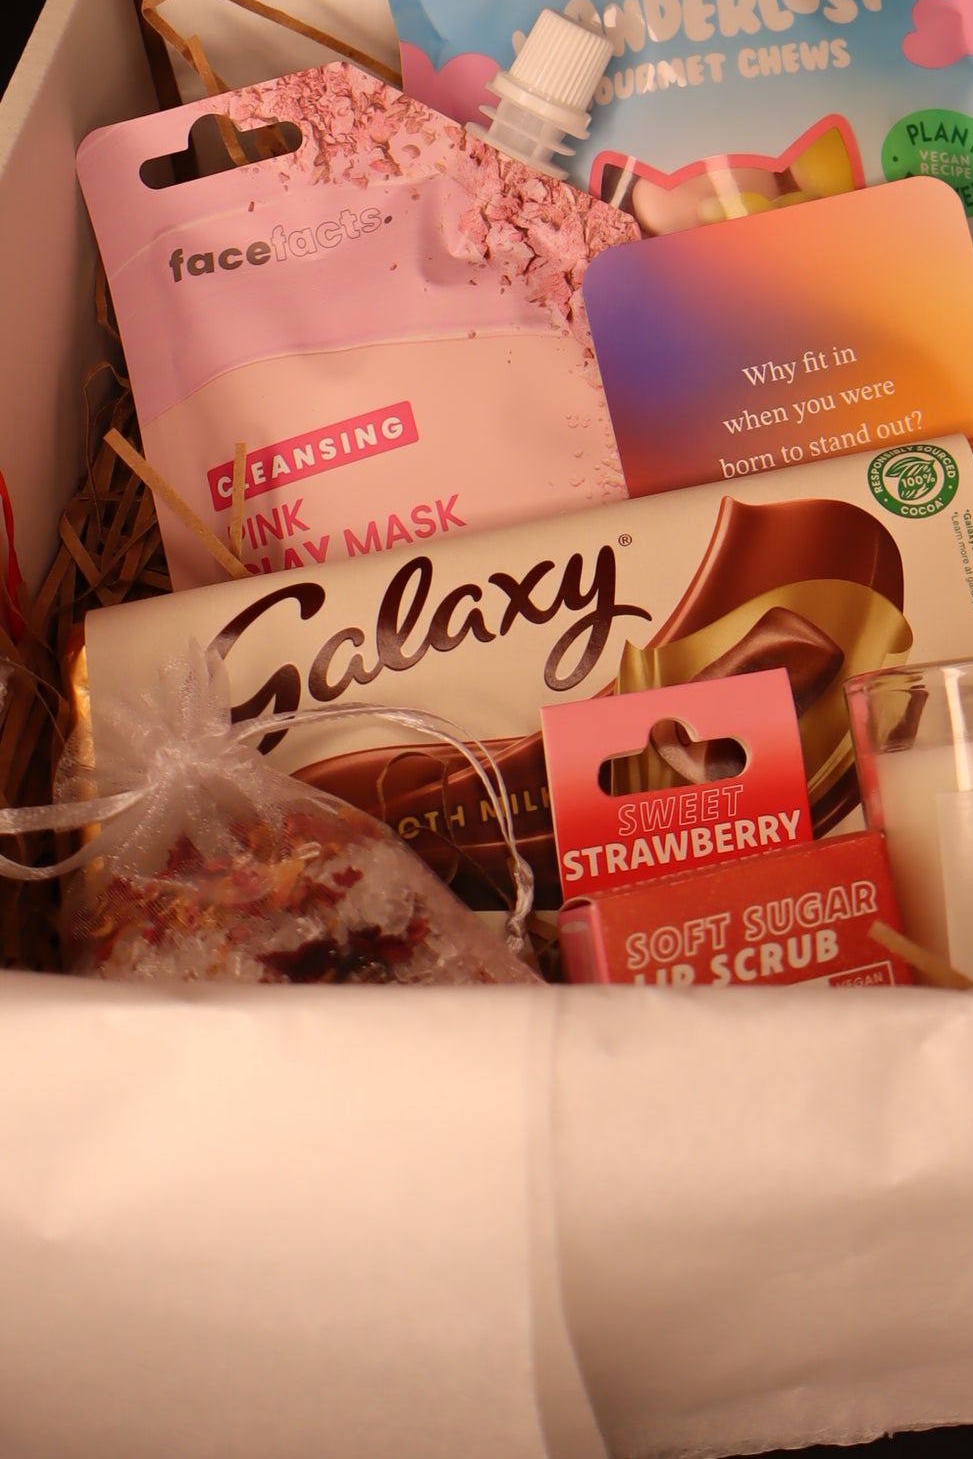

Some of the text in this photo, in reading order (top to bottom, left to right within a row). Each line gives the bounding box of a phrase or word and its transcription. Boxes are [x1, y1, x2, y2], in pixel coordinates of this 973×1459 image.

[589, 38, 851, 109] OURMET CHEWS
[920, 150, 970, 165] VEGAN
[921, 162, 972, 179] RECIPE
[742, 346, 857, 387] Why fit in
[723, 379, 896, 435] when you were
[217, 417, 403, 498] CEANSING
[719, 410, 923, 479] born to stand out?
[870, 445, 956, 494] RESPONSIBLY SOURCED
[901, 473, 936, 488] 100%
[343, 494, 467, 557] MASK
[618, 784, 744, 836] SWEET
[563, 809, 801, 881] STRAWBERRY
[625, 880, 878, 970] SOFT SUGAR
[711, 930, 839, 987] SCRUB
